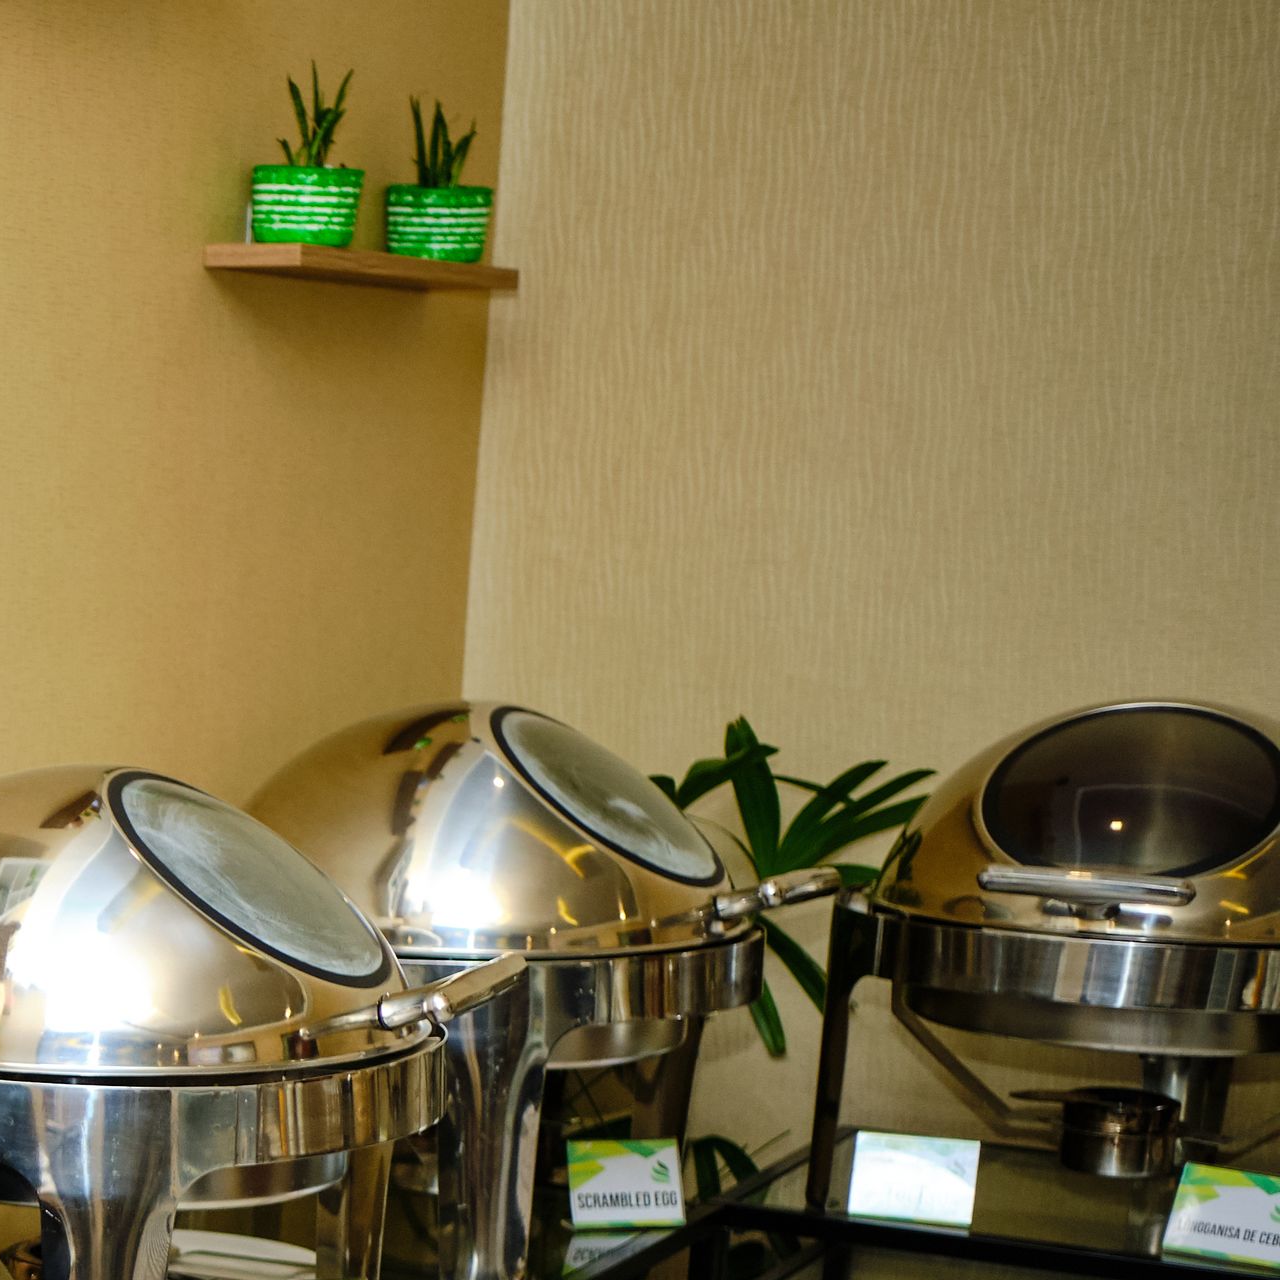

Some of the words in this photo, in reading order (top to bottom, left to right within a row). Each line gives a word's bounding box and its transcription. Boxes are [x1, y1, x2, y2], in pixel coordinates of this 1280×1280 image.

[577, 1192, 651, 1209] SCRAMBLED
[655, 1190, 678, 1207] EGG
[1243, 1228, 1258, 1242] DE
[1258, 1231, 1280, 1247] CEB
